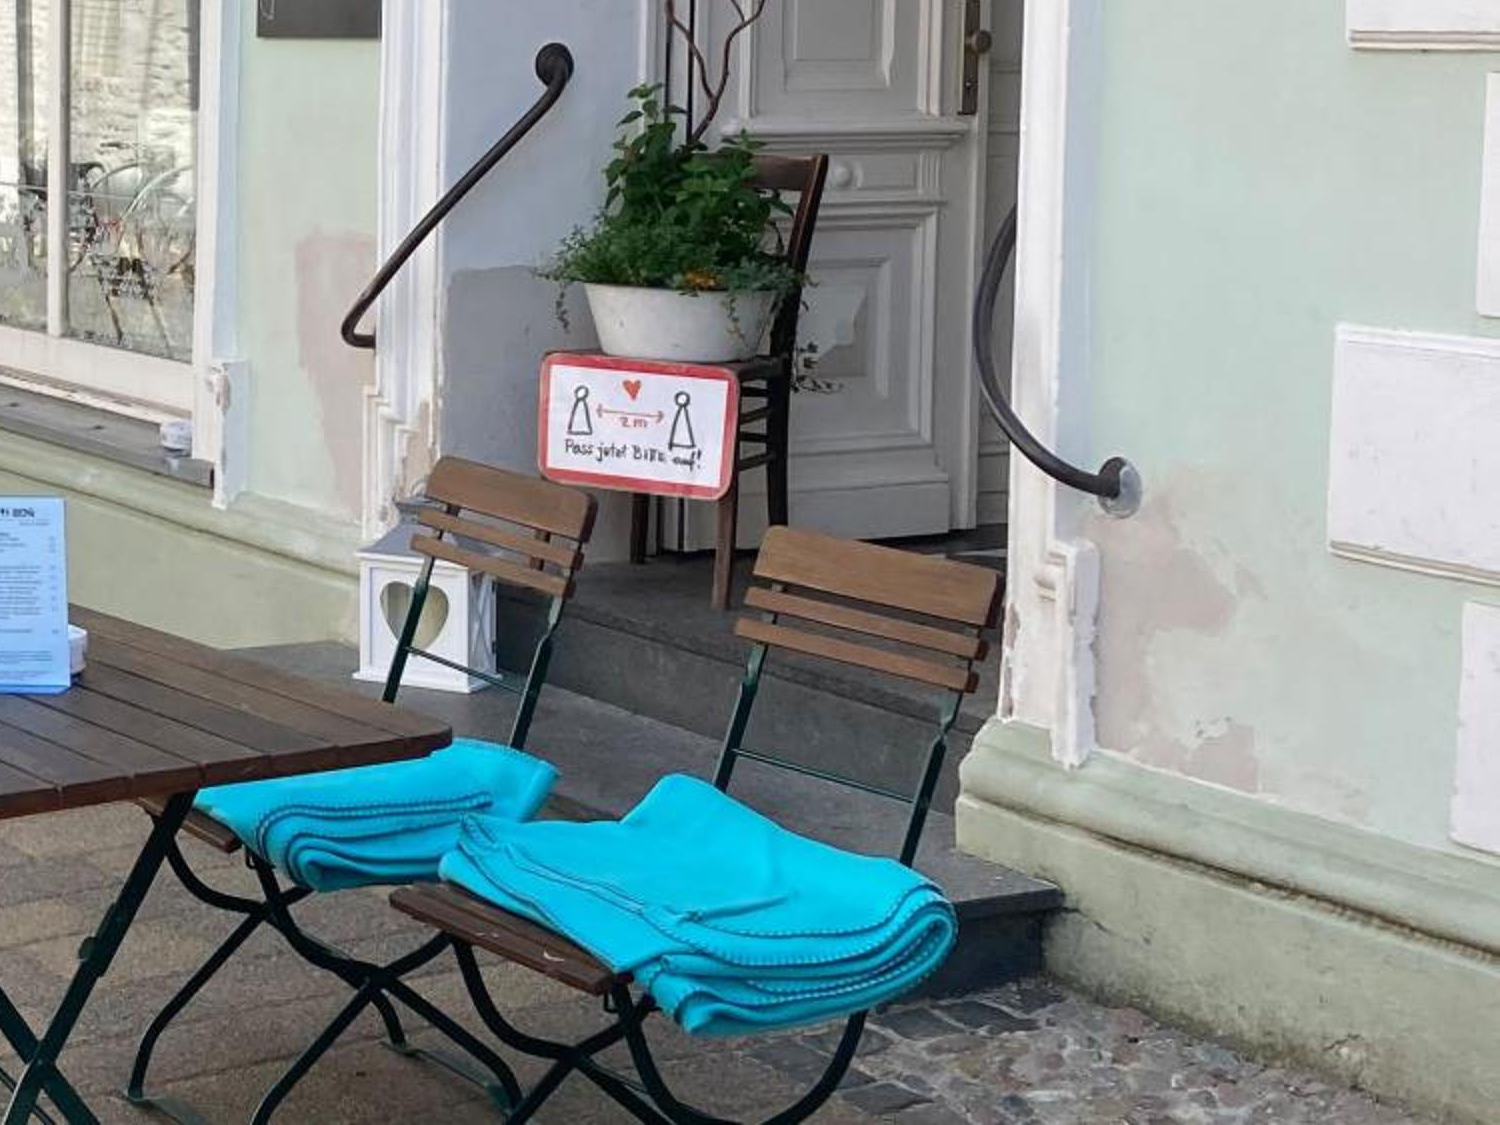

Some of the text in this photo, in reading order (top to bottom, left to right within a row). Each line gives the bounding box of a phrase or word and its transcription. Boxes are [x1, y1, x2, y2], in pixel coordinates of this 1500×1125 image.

[620, 417, 648, 429] 2 m
[565, 438, 593, 455] Pass
